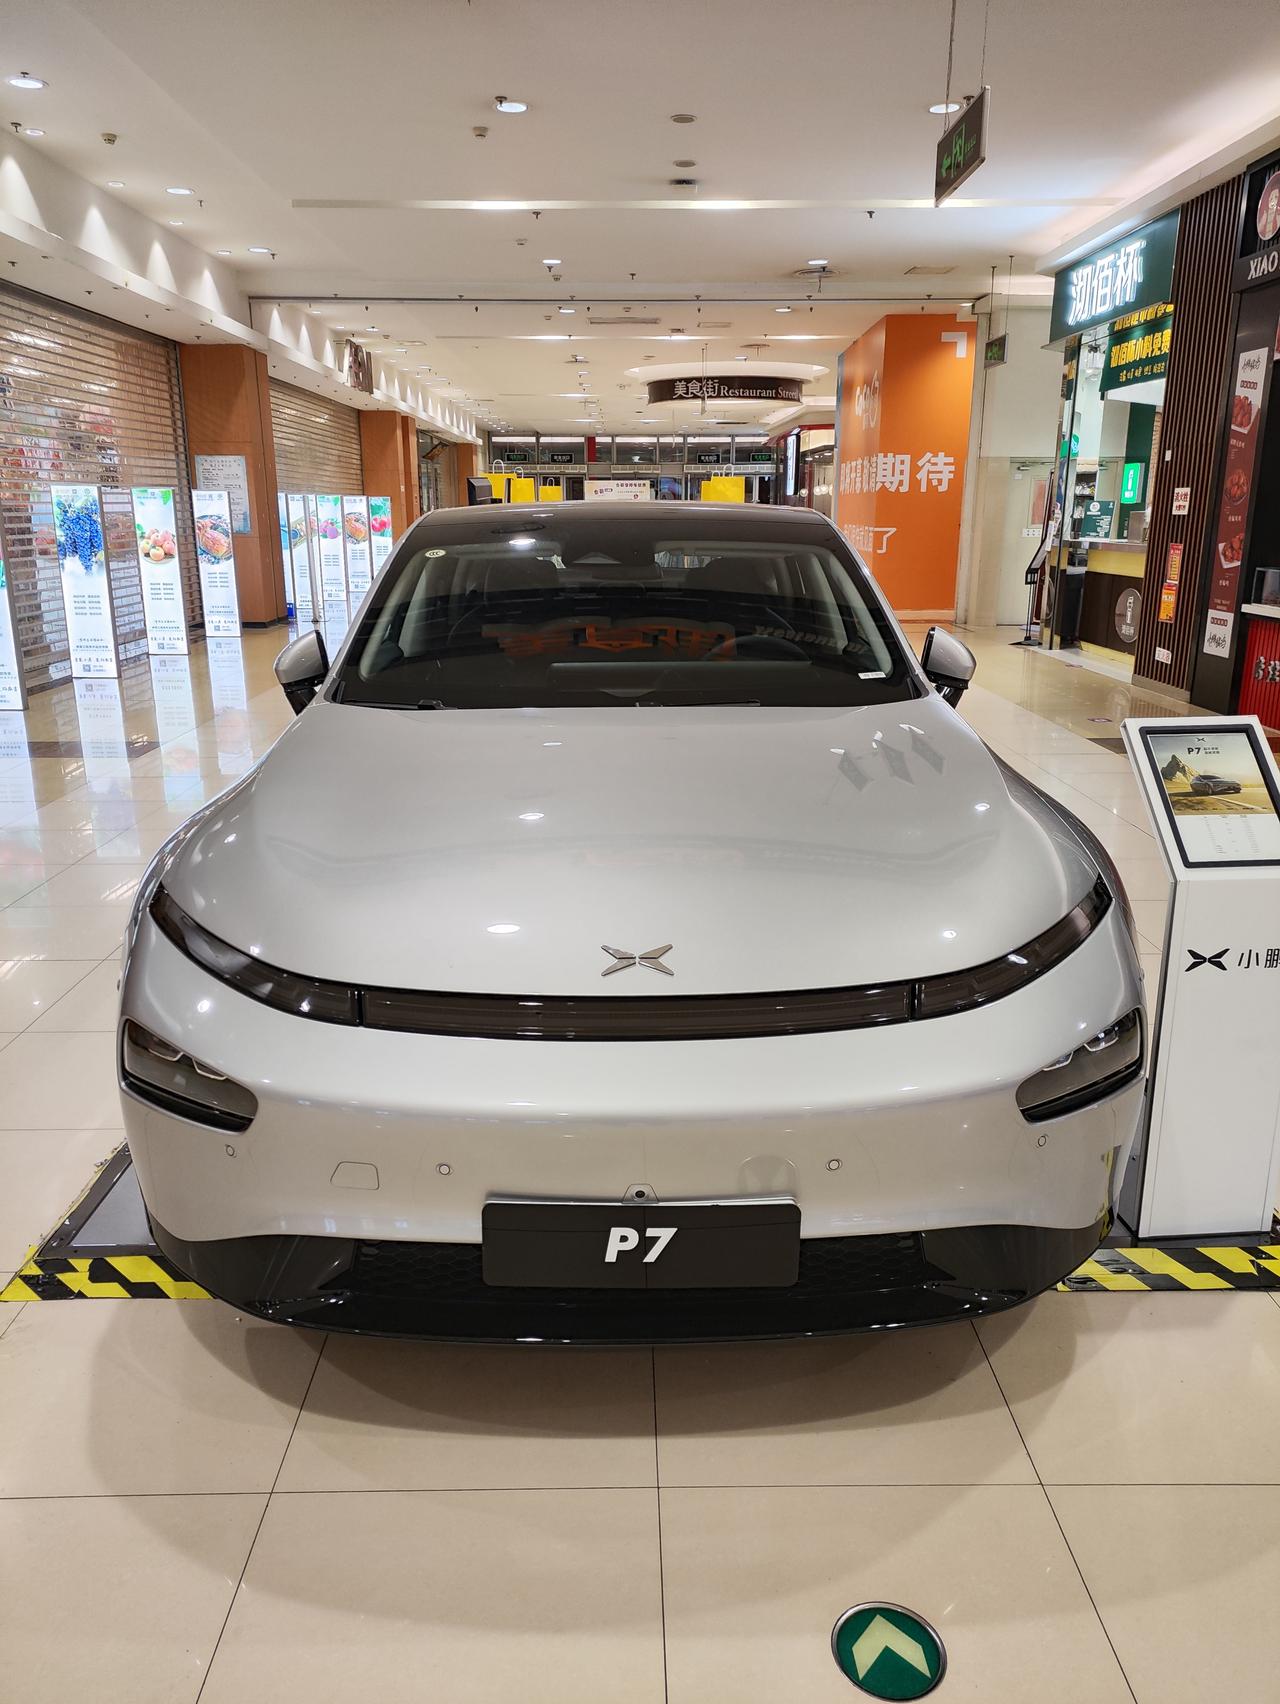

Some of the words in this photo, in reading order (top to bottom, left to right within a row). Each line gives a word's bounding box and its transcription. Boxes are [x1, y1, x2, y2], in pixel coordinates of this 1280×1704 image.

[1248, 251, 1279, 280] XIAO
[673, 379, 719, 399] 美食街
[720, 386, 776, 398] Restaurant
[1187, 747, 1201, 755] P7
[604, 1227, 678, 1263] P7
